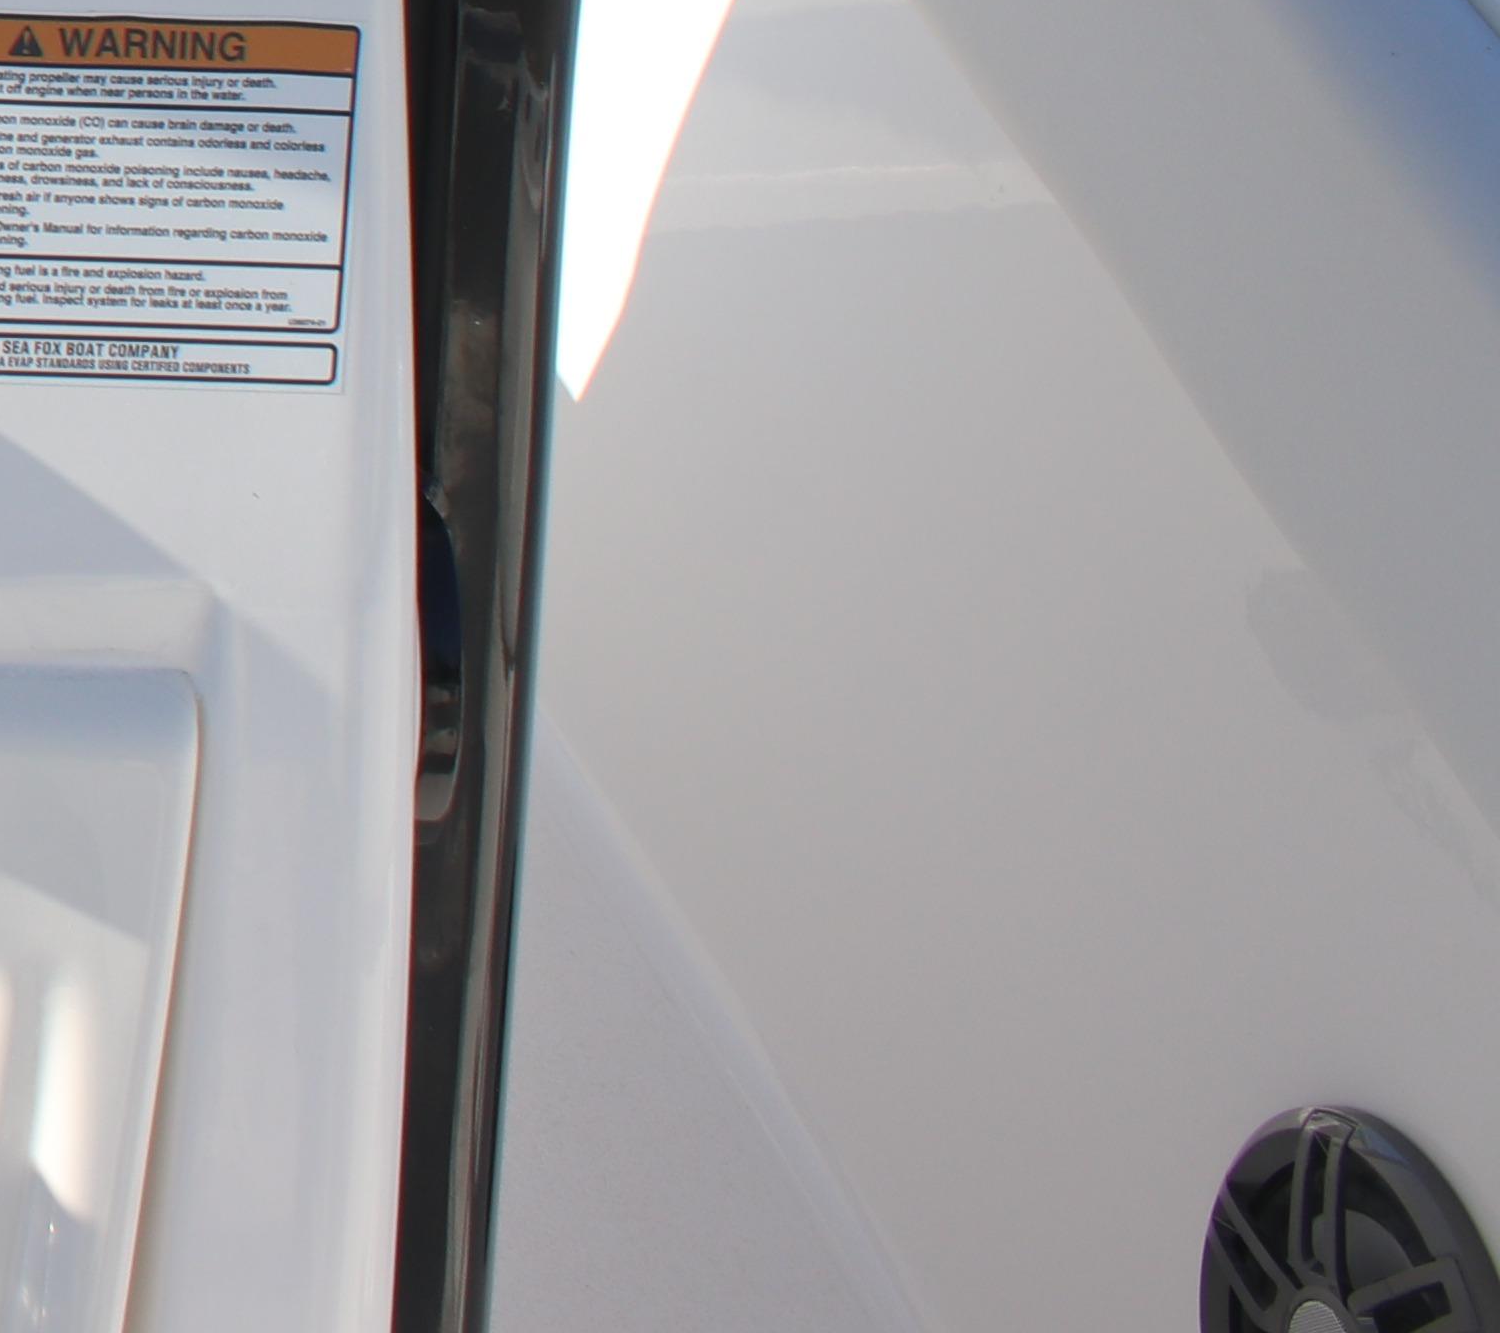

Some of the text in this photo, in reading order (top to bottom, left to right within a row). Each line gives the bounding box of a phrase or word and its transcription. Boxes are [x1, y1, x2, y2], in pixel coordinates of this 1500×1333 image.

[59, 28, 247, 62] WARNING
[28, 70, 80, 86] propeller
[82, 74, 107, 86] may
[109, 75, 144, 85] cause
[146, 74, 188, 86] serious
[190, 75, 224, 90] injury
[226, 78, 239, 88] or
[241, 76, 277, 89] death.
[6, 82, 22, 94] off
[24, 83, 63, 98] engine
[66, 84, 97, 97] when
[99, 88, 125, 97] near
[127, 89, 174, 102] persons
[176, 87, 188, 99] in
[190, 88, 209, 100] the
[211, 88, 246, 101] water.
[2, 340, 179, 359] SEA FOX BOAT COMPANY
[7, 356, 33, 369] EVAP
[36, 357, 95, 370] STANDARDS
[98, 359, 128, 371] USING
[131, 360, 180, 373] CERTIFIED
[182, 361, 250, 375] COMPONENTS
